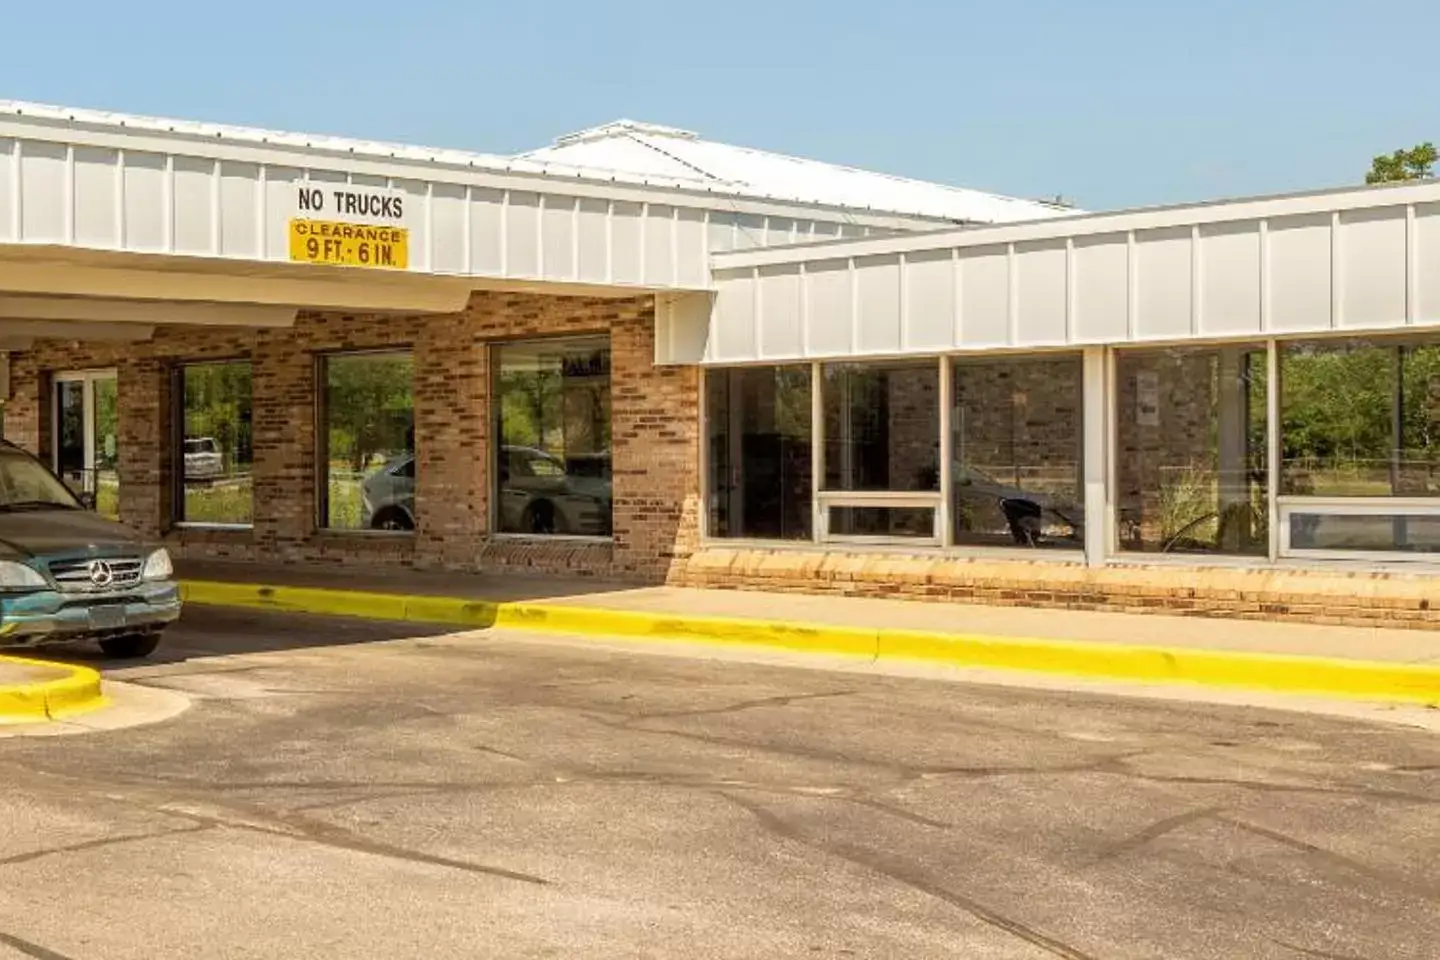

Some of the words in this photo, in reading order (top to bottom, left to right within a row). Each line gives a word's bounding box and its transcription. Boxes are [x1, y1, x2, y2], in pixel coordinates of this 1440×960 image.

[298, 188, 323, 210] NO
[334, 192, 402, 218] TRUCKS
[295, 223, 401, 242] CLEARANCE
[307, 238, 319, 258] 9
[359, 243, 369, 263] 6
